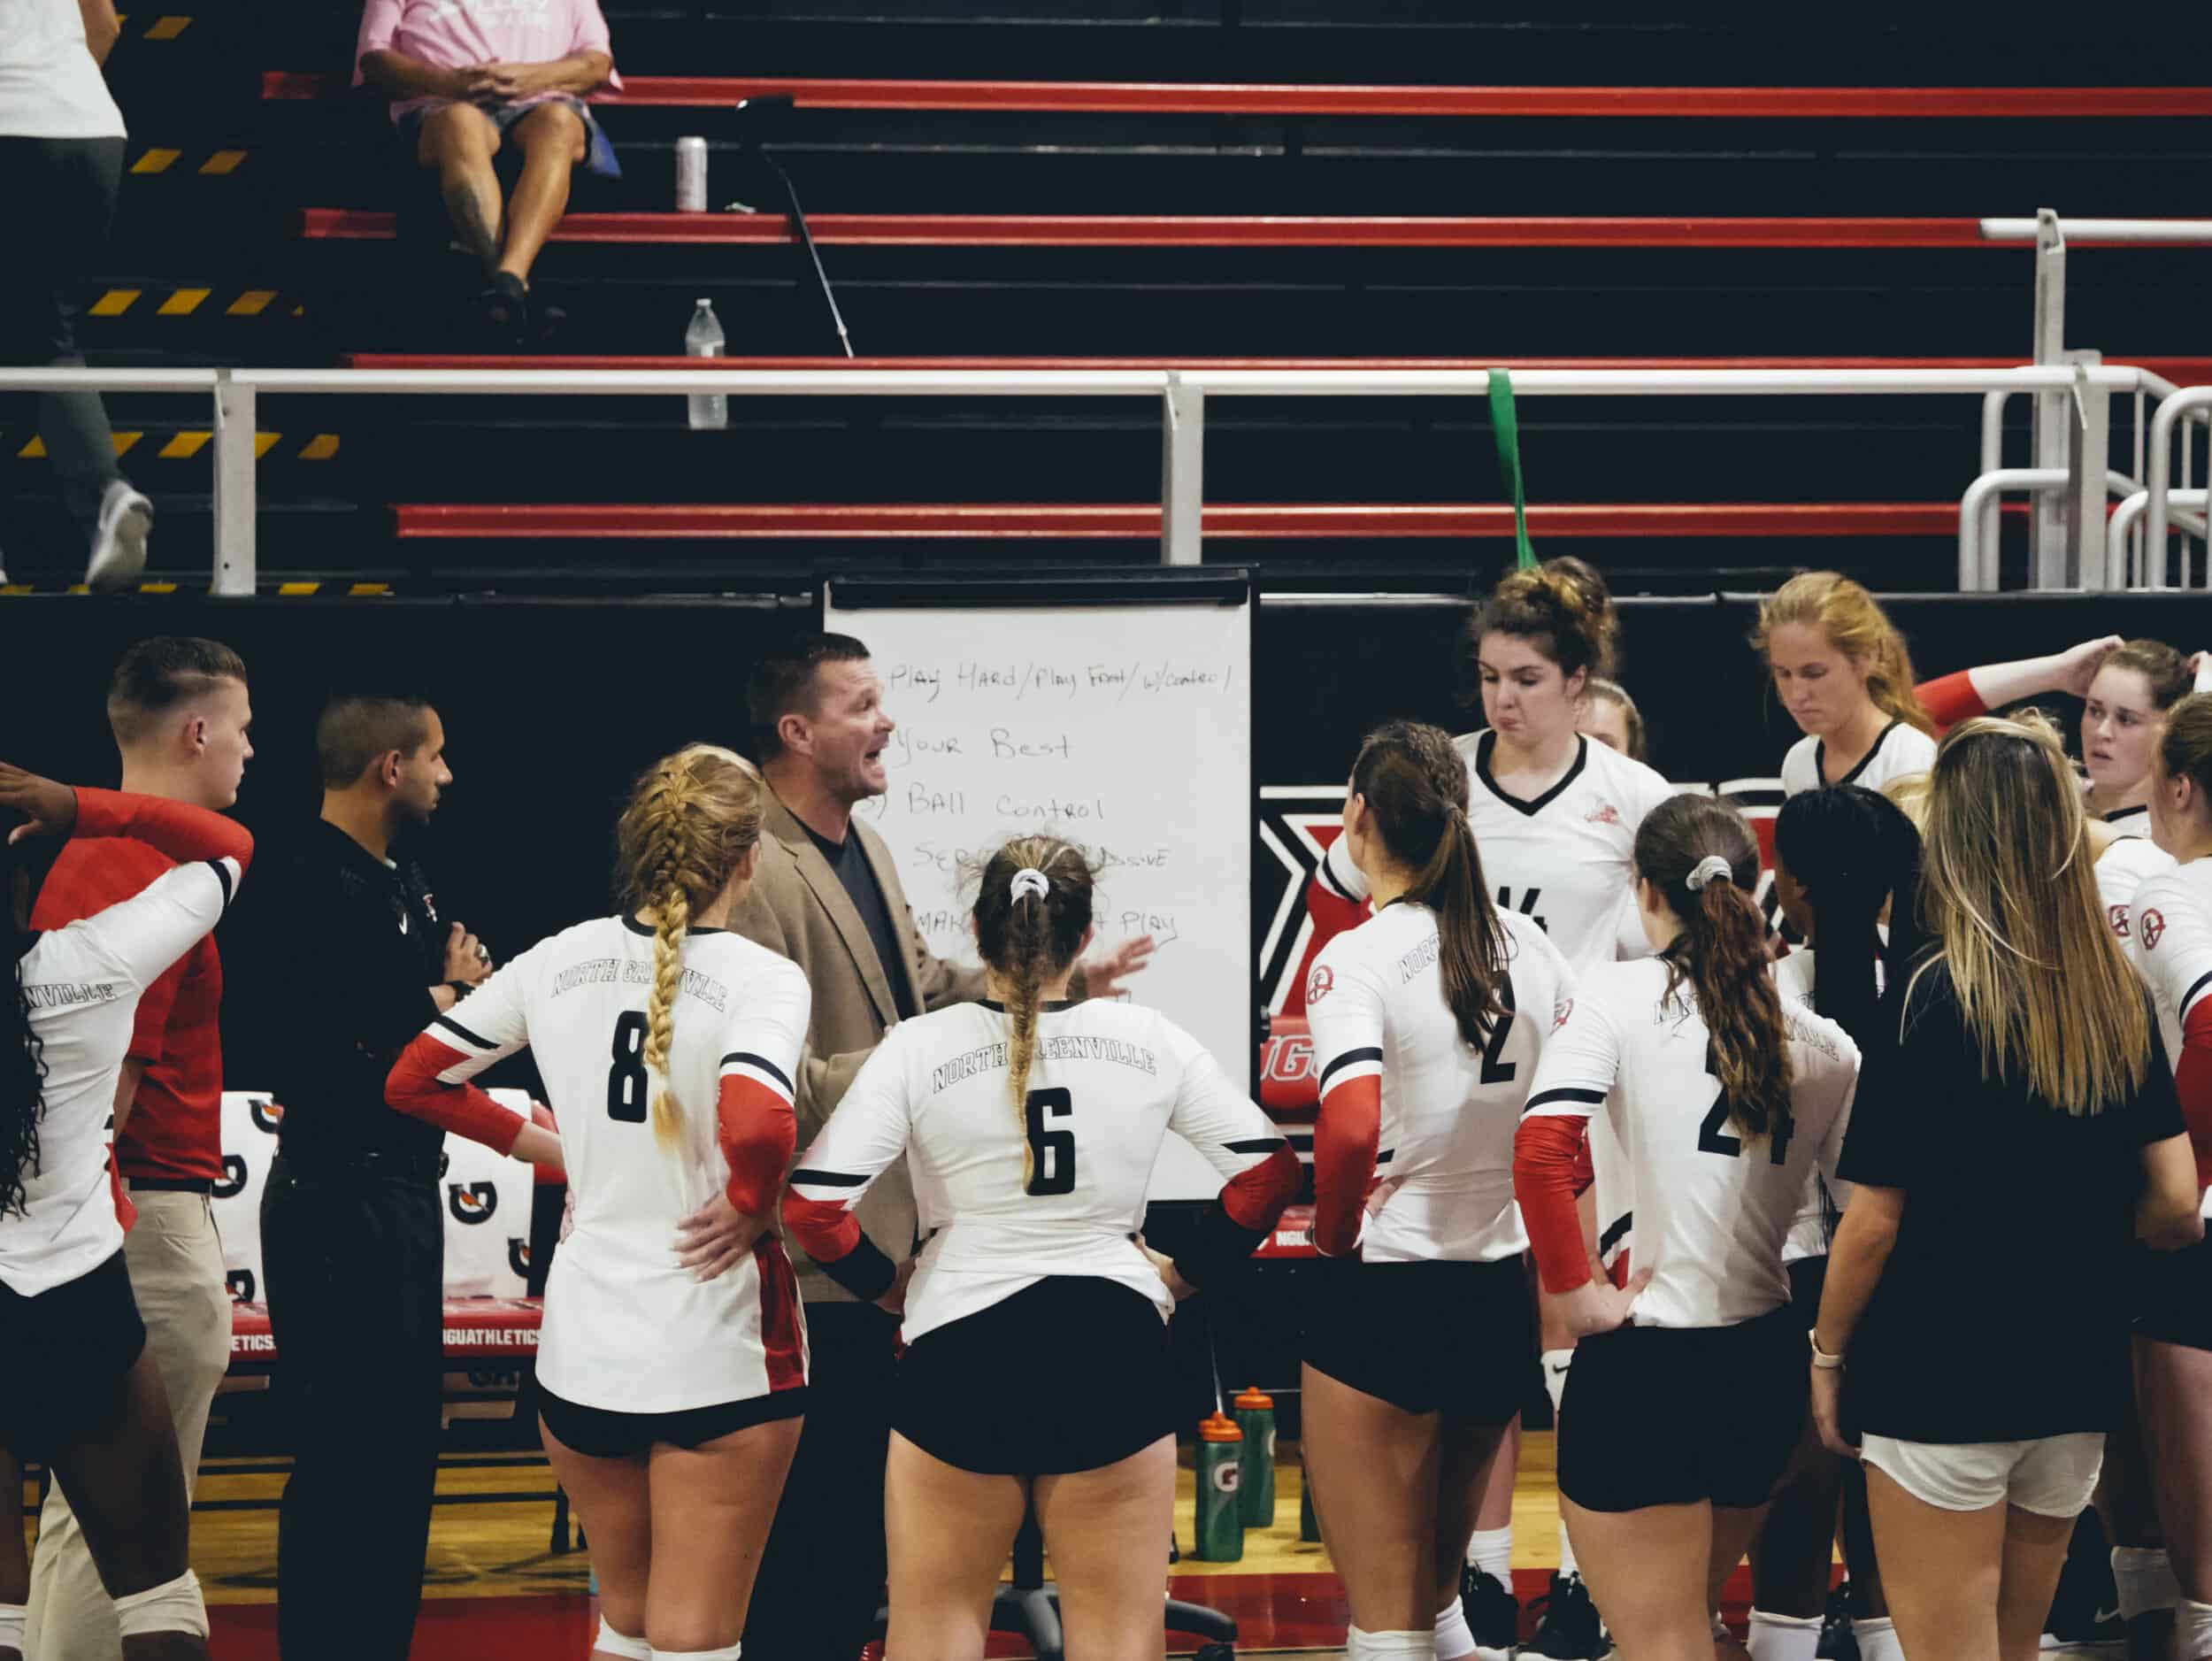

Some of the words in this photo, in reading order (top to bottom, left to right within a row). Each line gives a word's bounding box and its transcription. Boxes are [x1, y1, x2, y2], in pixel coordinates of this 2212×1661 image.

[990, 727, 1072, 758] Best
[550, 958, 619, 998] NORTH
[607, 1011, 650, 1123] 8
[933, 1042, 1008, 1095] NORTH
[1025, 1087, 1076, 1196] 6
